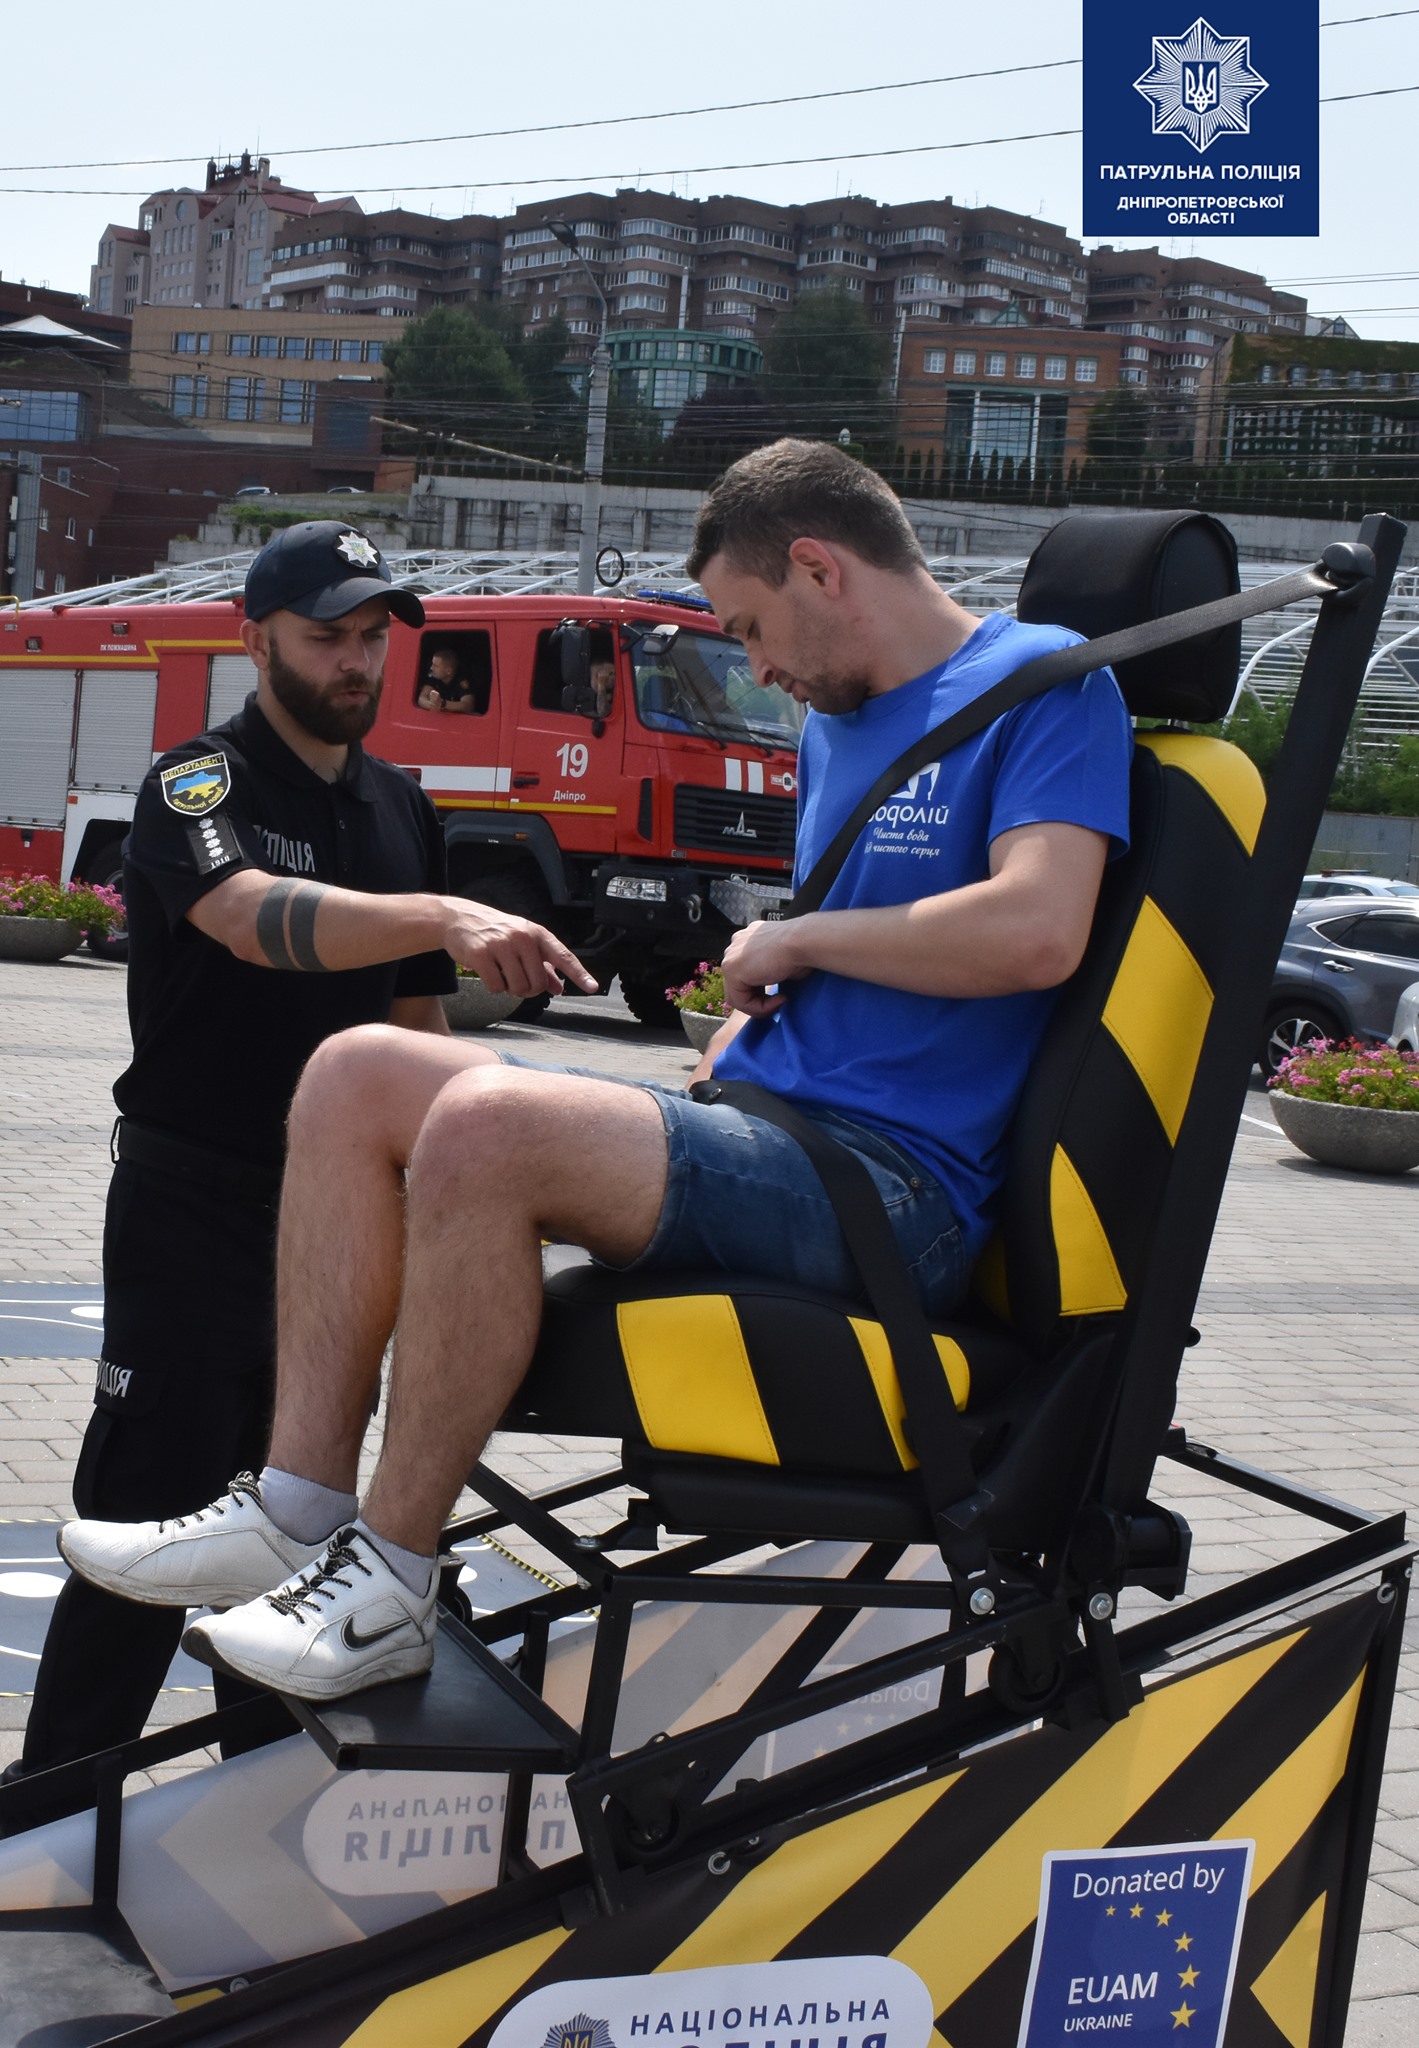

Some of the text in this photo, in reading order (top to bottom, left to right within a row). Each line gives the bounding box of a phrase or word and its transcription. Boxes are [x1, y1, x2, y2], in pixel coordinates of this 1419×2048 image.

[164, 756, 223, 780] ДЕПАРТАМЕНТ
[556, 743, 588, 778] 19
[553, 790, 586, 803] Дніпро
[907, 829, 929, 841] вода
[911, 847, 940, 859] серця
[1073, 1862, 1225, 1898] Donated by
[1067, 1972, 1158, 2005] EUAM
[630, 1998, 890, 2037] НАЦІОНАЛЬНА
[1064, 2013, 1133, 2032] UKRAINE
